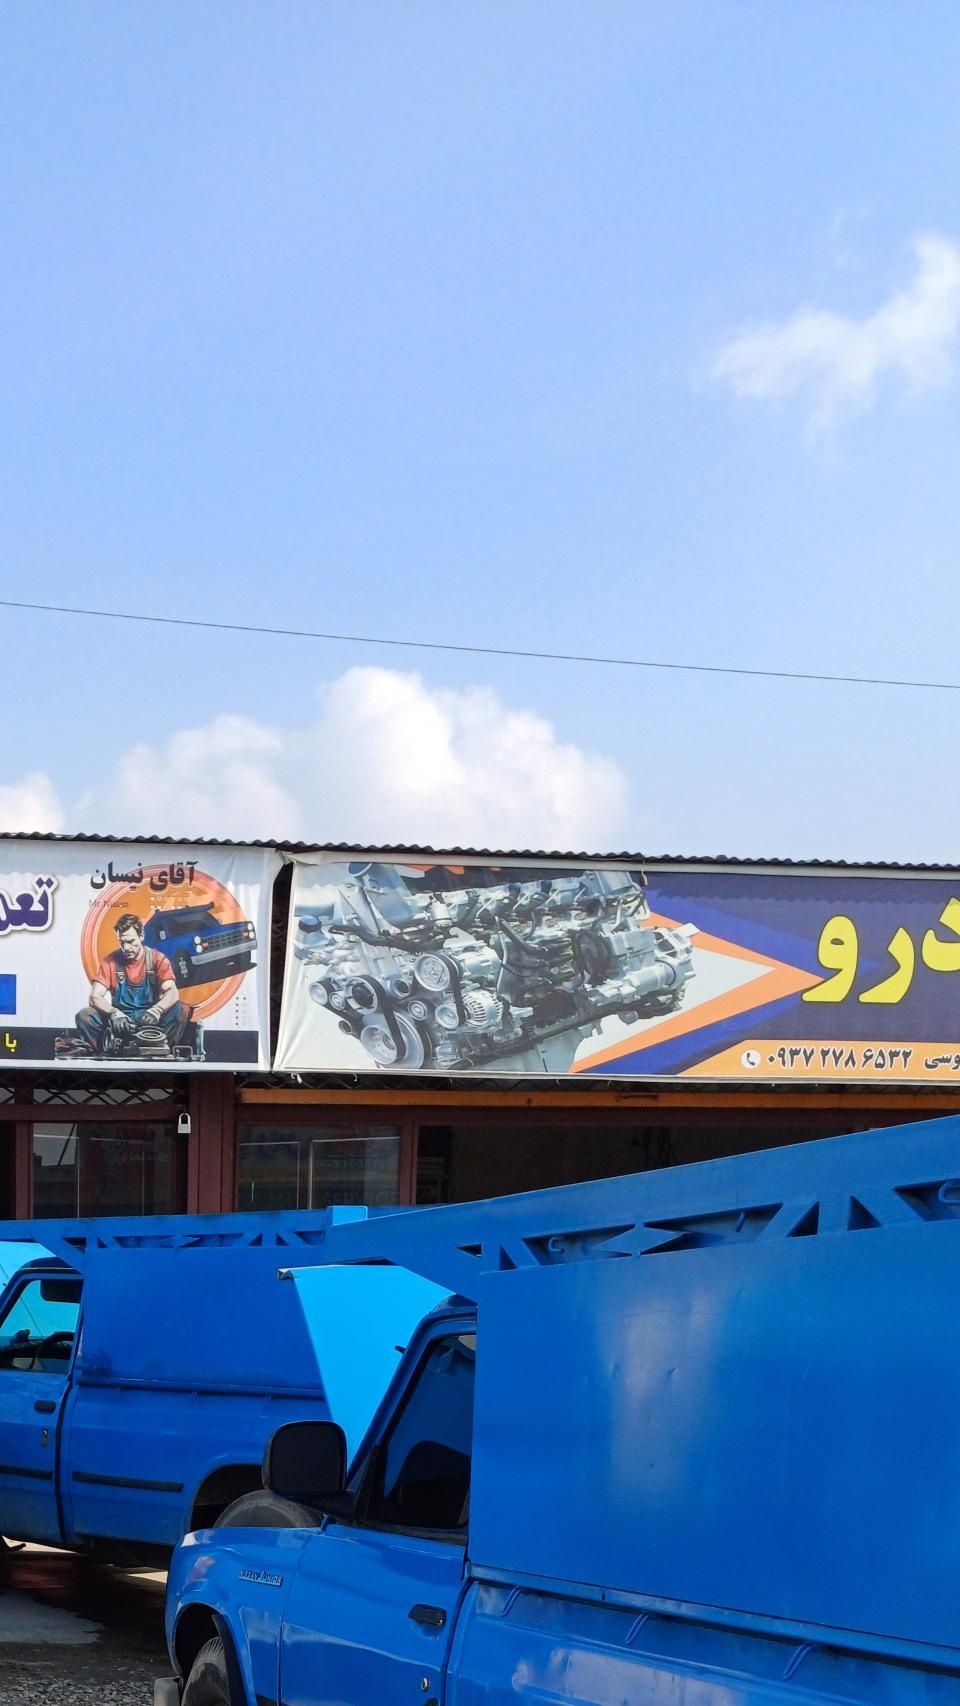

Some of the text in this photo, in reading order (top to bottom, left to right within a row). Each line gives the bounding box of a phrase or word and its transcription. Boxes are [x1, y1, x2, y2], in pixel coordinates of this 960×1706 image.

[90, 860, 199, 892] آقای نیسان
[5, 1032, 17, 1053] با
[767, 1046, 913, 1070] ۰۹۳۷ ۲۷۸ ۶۵۳۲
